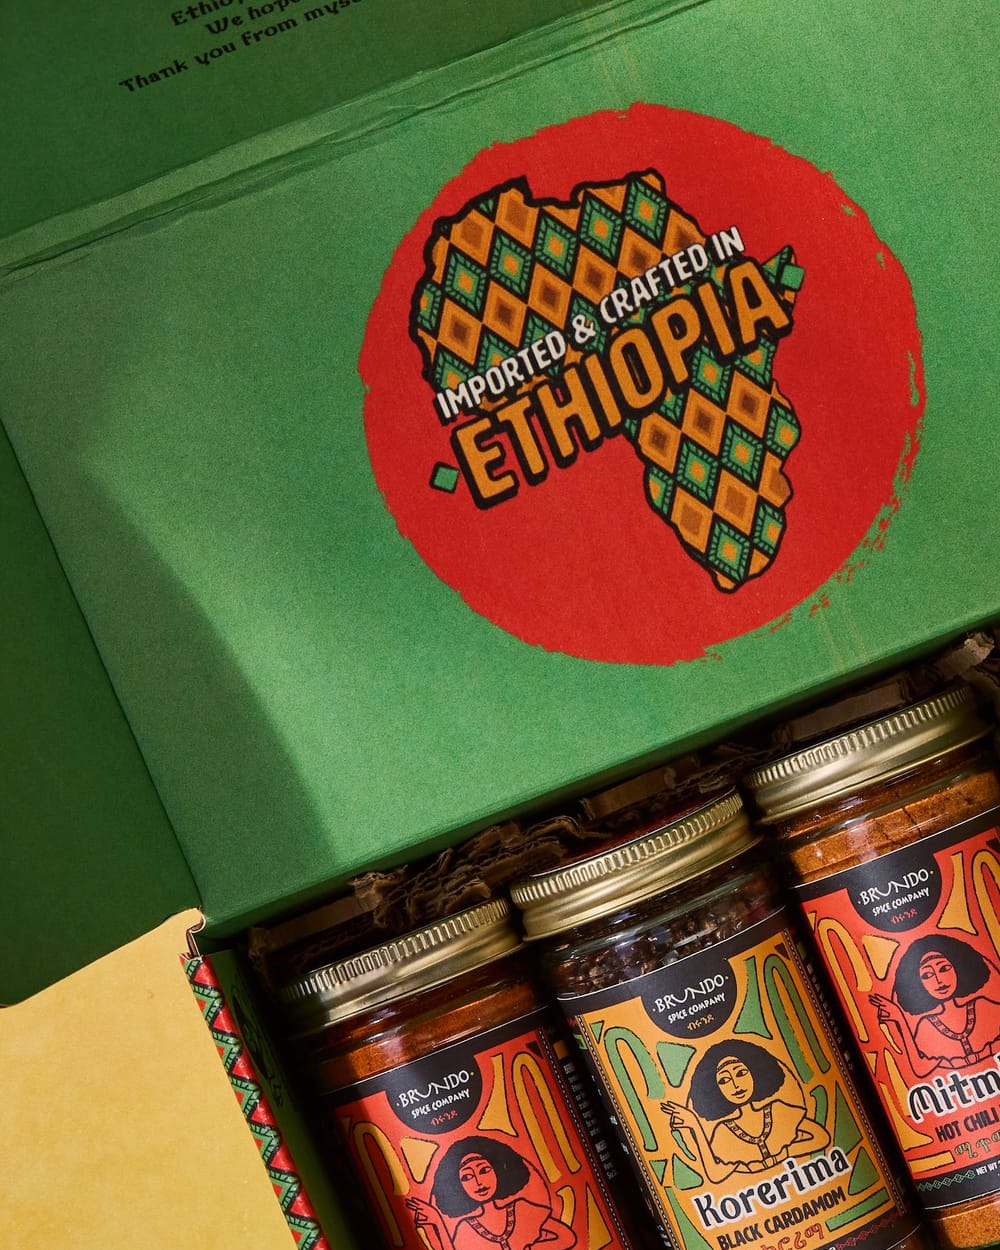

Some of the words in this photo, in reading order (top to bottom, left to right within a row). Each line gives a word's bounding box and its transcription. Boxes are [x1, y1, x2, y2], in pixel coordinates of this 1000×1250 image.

[170, 0, 244, 26] Ethio
[205, 15, 243, 34] We
[118, 59, 189, 92] Thank
[194, 42, 236, 65] you
[436, 330, 566, 419] IMPORTED
[571, 313, 598, 344] &
[599, 243, 709, 325] CRAFTED
[711, 225, 745, 260] IN
[455, 260, 791, 500] ETHIOPIA
[860, 868, 929, 905] BRUNDO
[872, 902, 891, 917] SPICE
[891, 887, 929, 909] COMPANY
[654, 974, 725, 1013] BRUNDO
[668, 1009, 688, 1024] SPICE
[688, 992, 726, 1016] COMPANY
[399, 1070, 469, 1107] BRUNDO
[411, 1103, 431, 1119] SPICE
[431, 1088, 470, 1111] COMPANY
[935, 1120, 963, 1143] HOT
[963, 1107, 1000, 1133] CHILI
[693, 1148, 850, 1227] Korerima
[975, 1165, 989, 1177] NET
[987, 1161, 999, 1172] WT
[716, 1223, 763, 1250] BLACK
[763, 1186, 847, 1234] CARDAMOM
